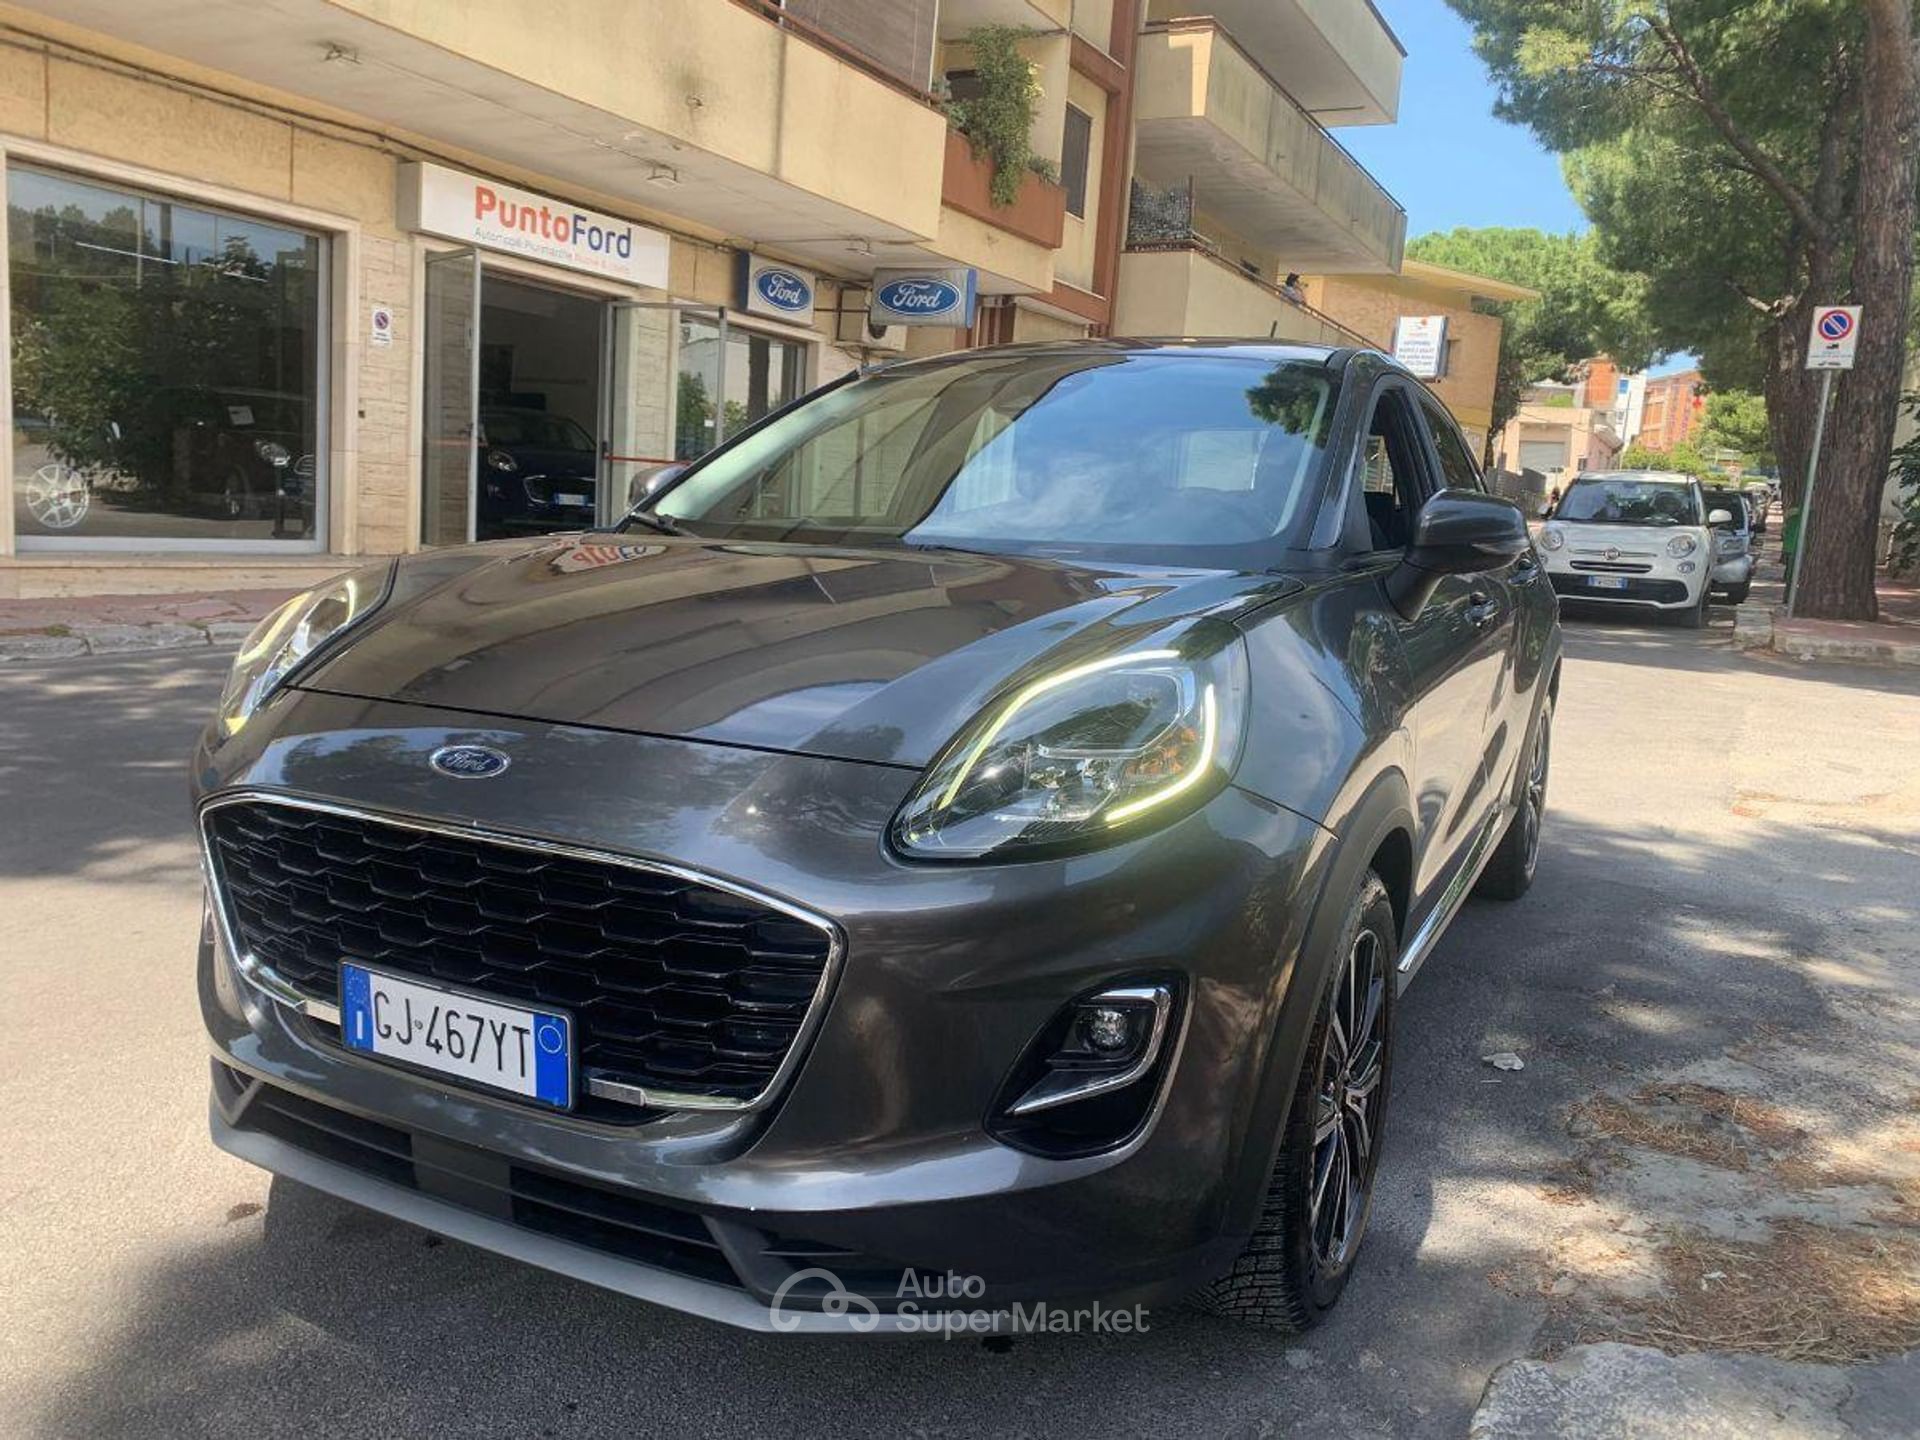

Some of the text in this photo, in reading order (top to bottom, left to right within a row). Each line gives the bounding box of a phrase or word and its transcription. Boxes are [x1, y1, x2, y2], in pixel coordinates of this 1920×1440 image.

[475, 185, 631, 258] PuntoFord
[768, 273, 802, 304] Ford
[892, 283, 941, 308] Ford
[446, 750, 493, 771] Ford
